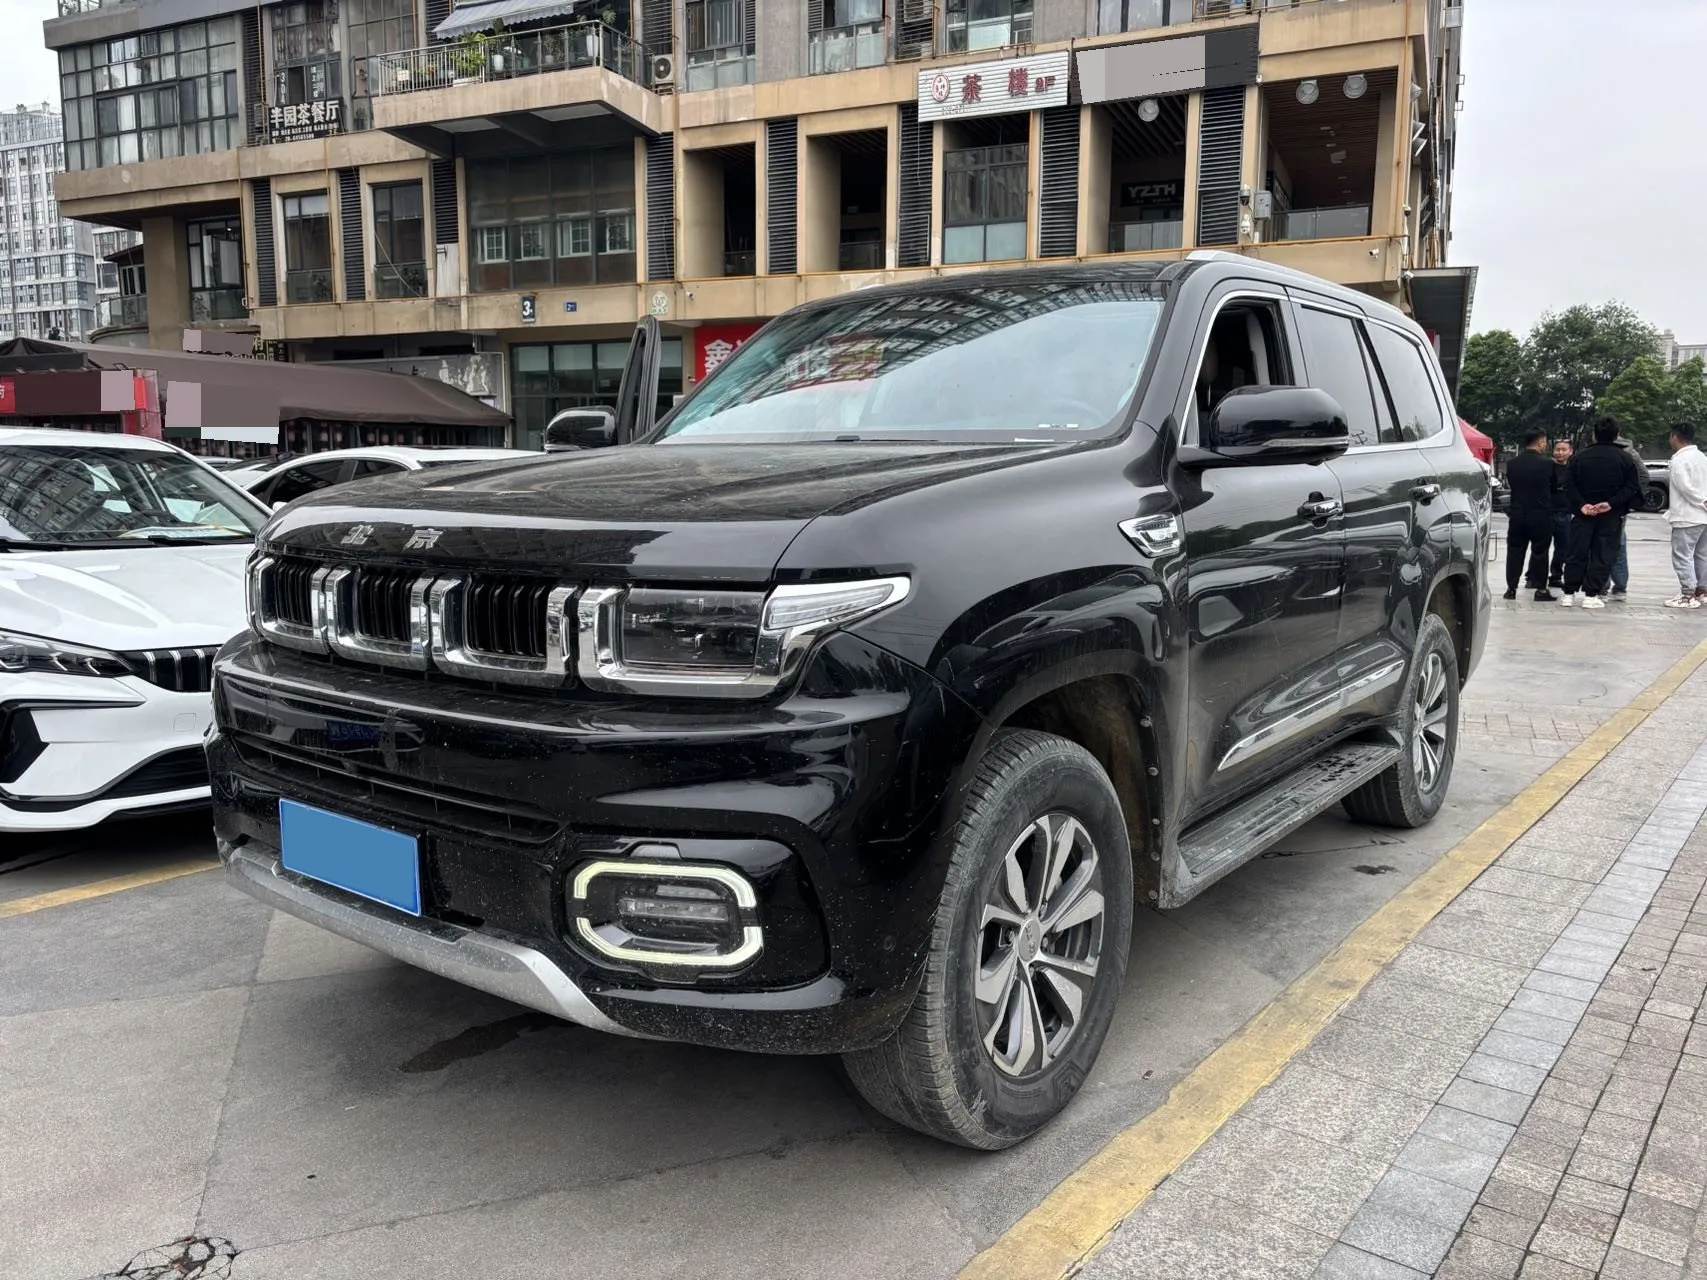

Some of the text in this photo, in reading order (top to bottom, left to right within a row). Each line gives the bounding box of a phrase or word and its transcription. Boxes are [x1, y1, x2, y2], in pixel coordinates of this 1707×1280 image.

[961, 67, 1029, 103] 茶楼
[270, 100, 340, 129] 半园茶餐厅
[341, 525, 444, 551] 北京
